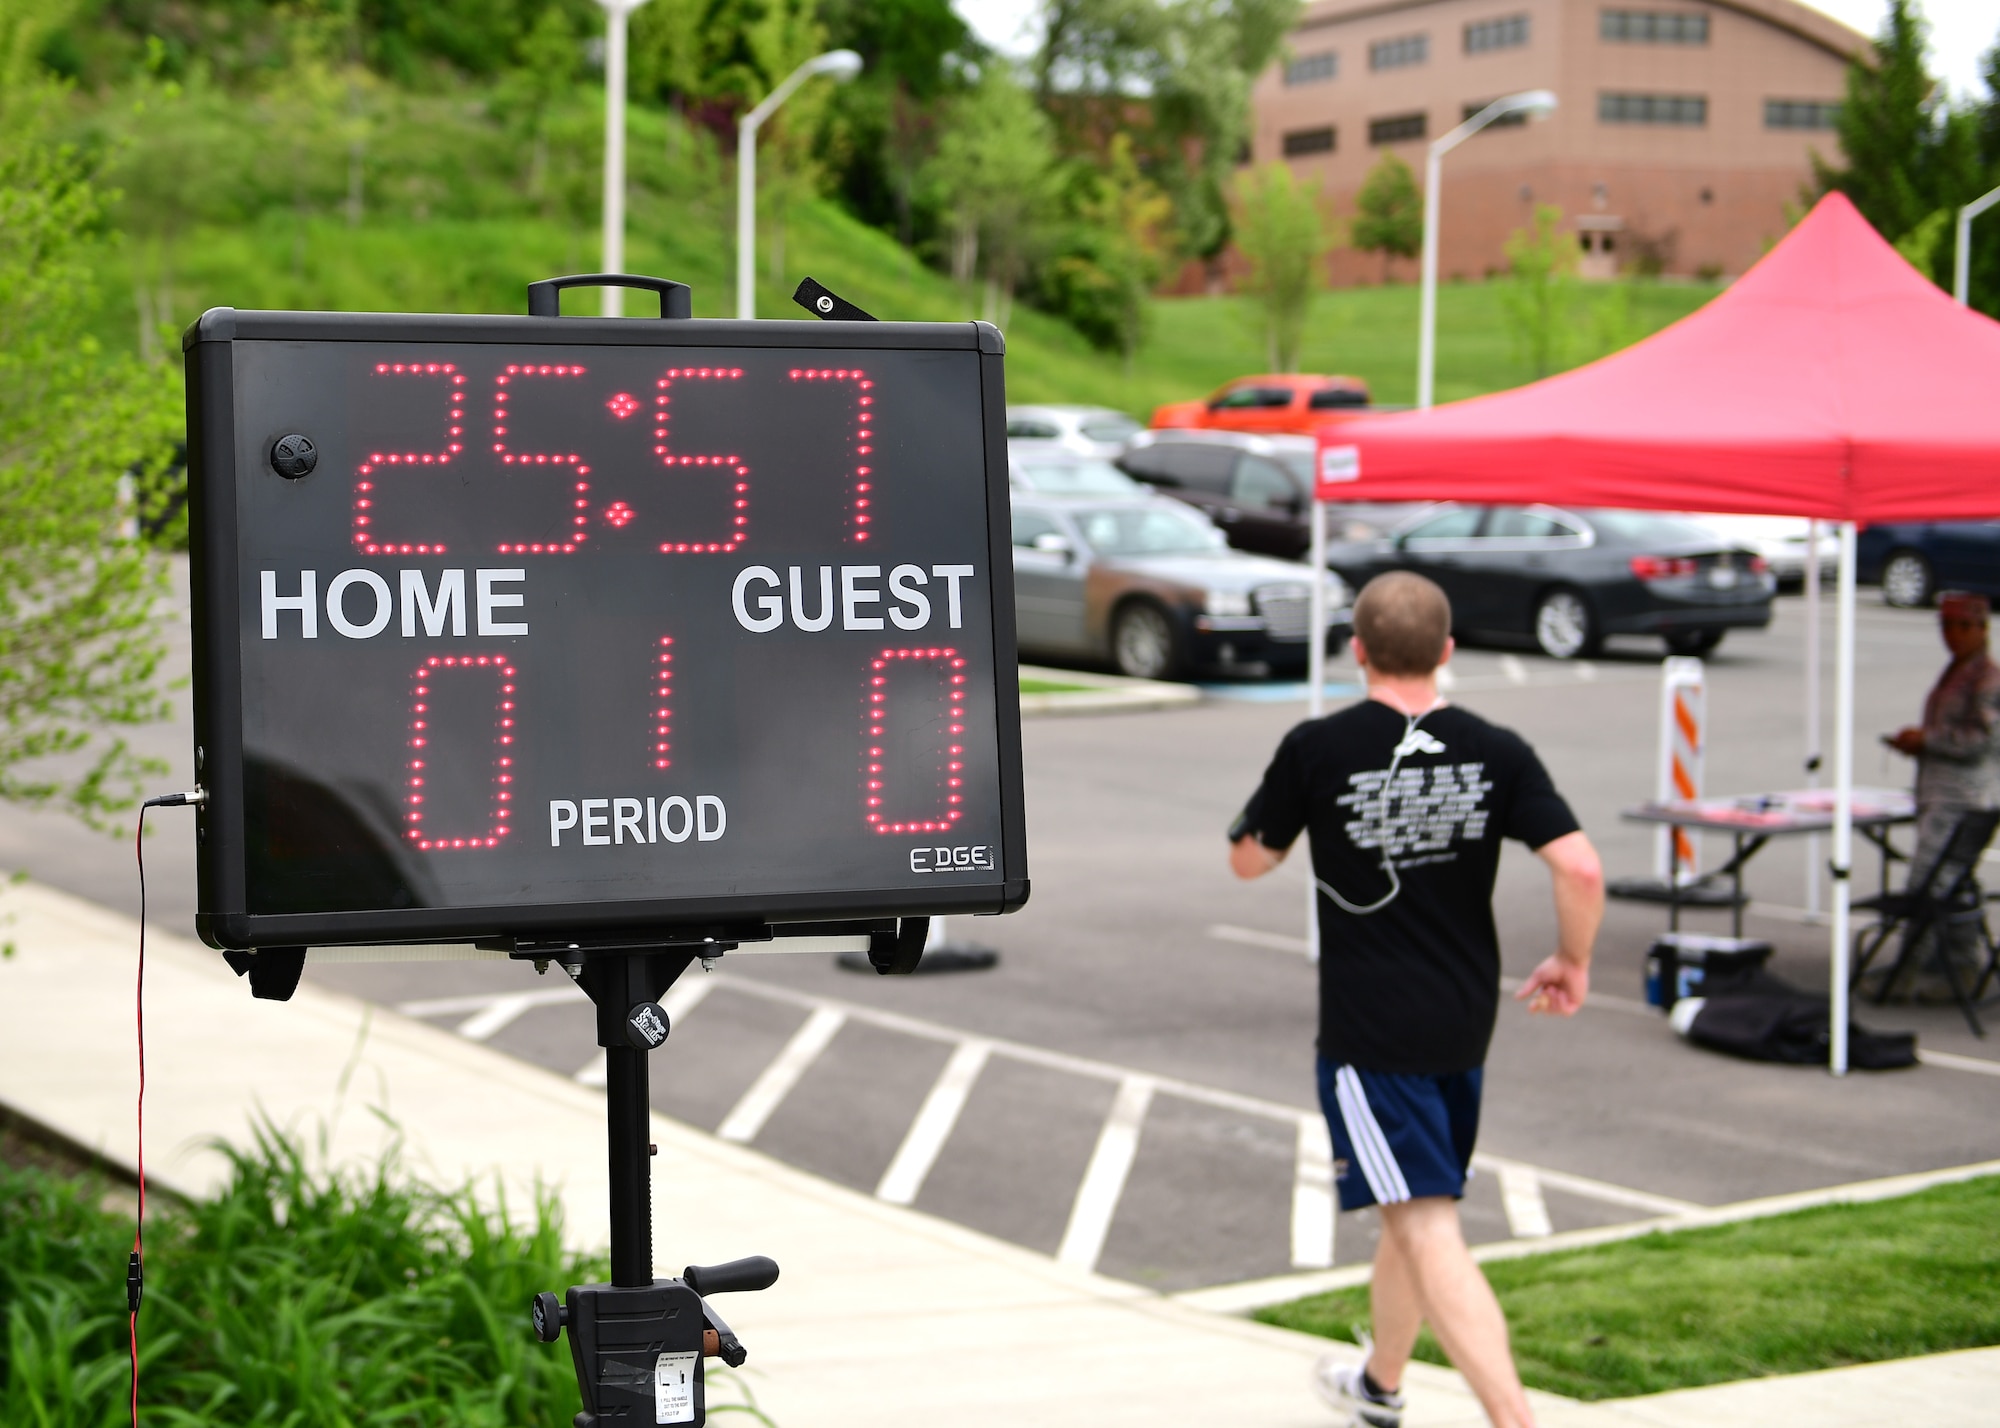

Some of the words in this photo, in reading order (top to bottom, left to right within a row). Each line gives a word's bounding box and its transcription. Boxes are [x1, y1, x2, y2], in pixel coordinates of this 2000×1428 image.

[353, 362, 875, 553] 25:57
[260, 568, 529, 639] HOME
[731, 564, 974, 633] GUEST
[408, 655, 516, 853] 0
[653, 635, 674, 771] 1
[866, 647, 967, 835] 0
[549, 794, 727, 847] PERIOD
[910, 846, 988, 873] EDGE
